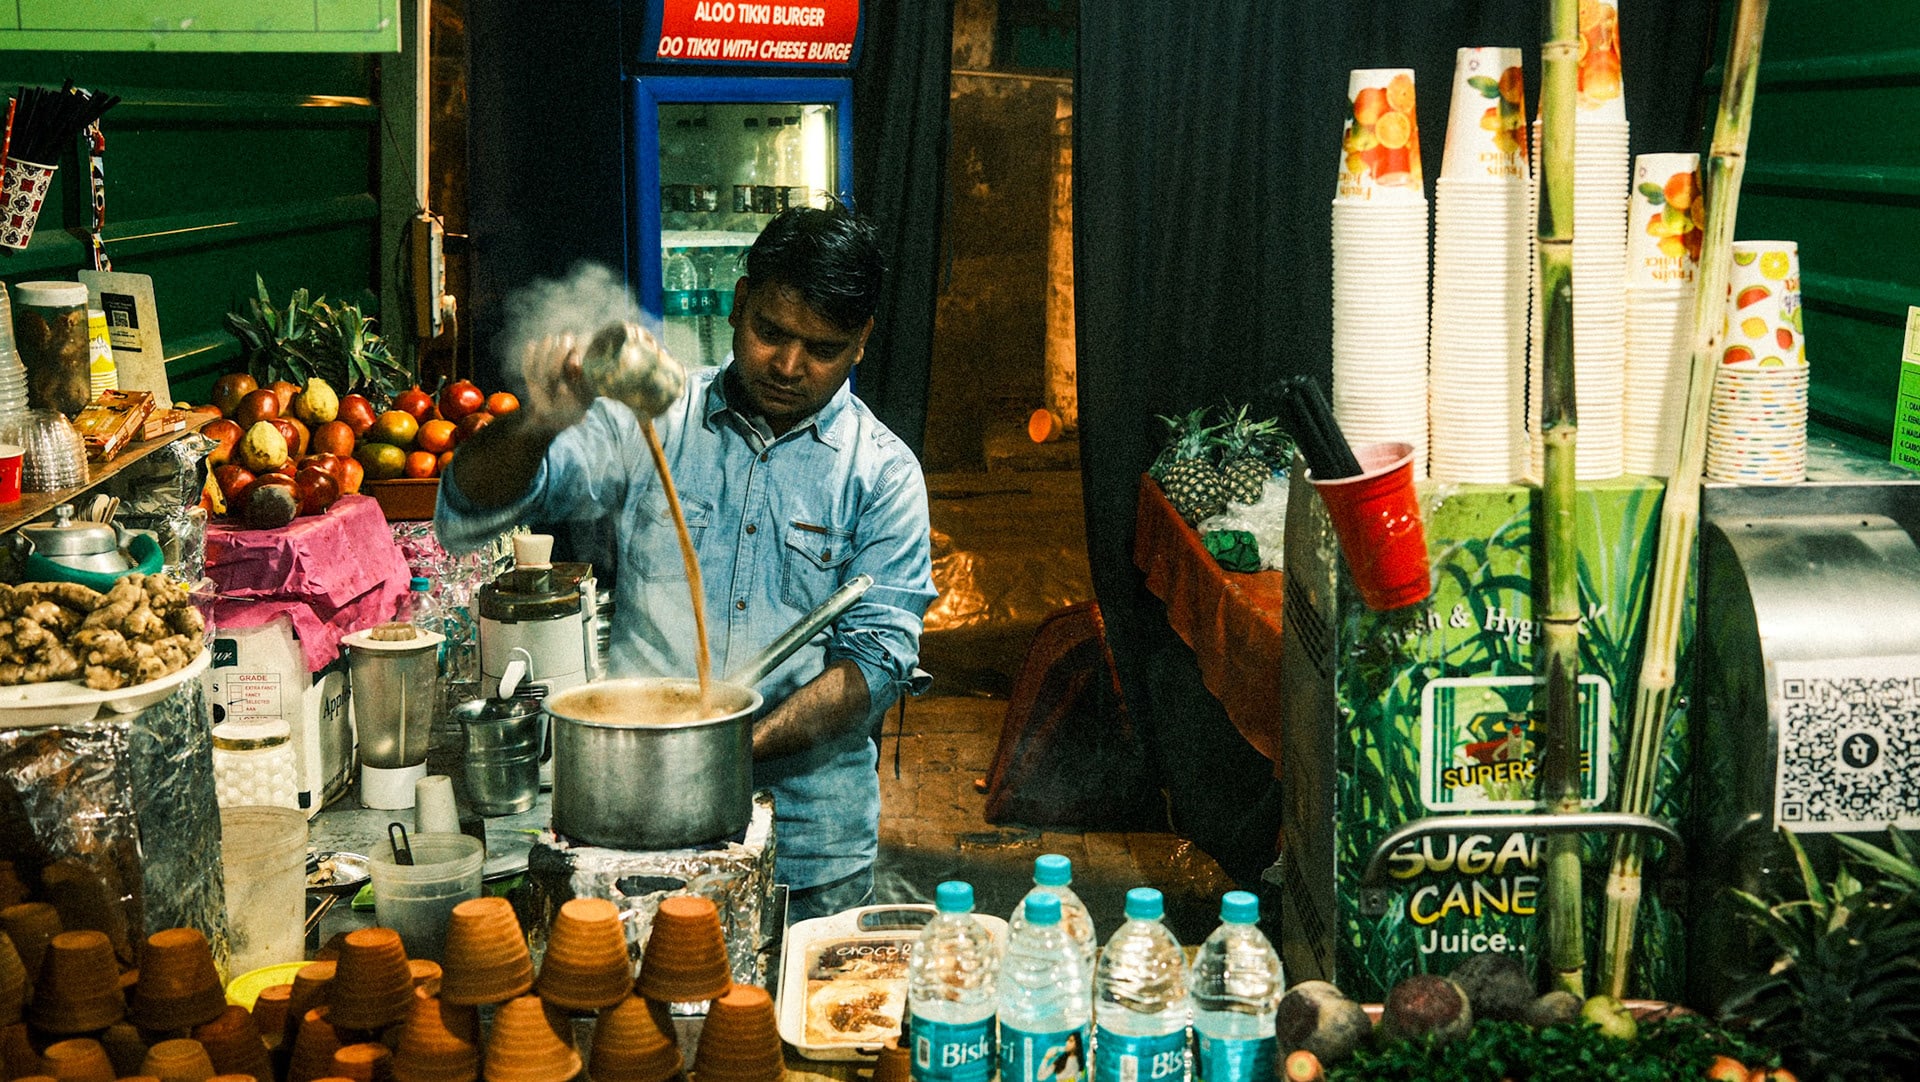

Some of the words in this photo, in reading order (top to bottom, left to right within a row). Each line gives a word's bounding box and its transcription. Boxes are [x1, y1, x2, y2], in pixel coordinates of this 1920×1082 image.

[694, 3, 736, 23] ALOO
[738, 4, 770, 25] TIKKI
[773, 5, 826, 27] BURGER
[657, 36, 684, 57] OO
[687, 38, 719, 58] TIKKI
[723, 39, 756, 59] WITH
[759, 40, 807, 60] CHEESE
[808, 42, 852, 61] BURGE
[1651, 269, 1693, 283] Fruits
[1450, 603, 1472, 628] &
[1409, 875, 1540, 926] CANE
[1420, 928, 1527, 955] Juice..
